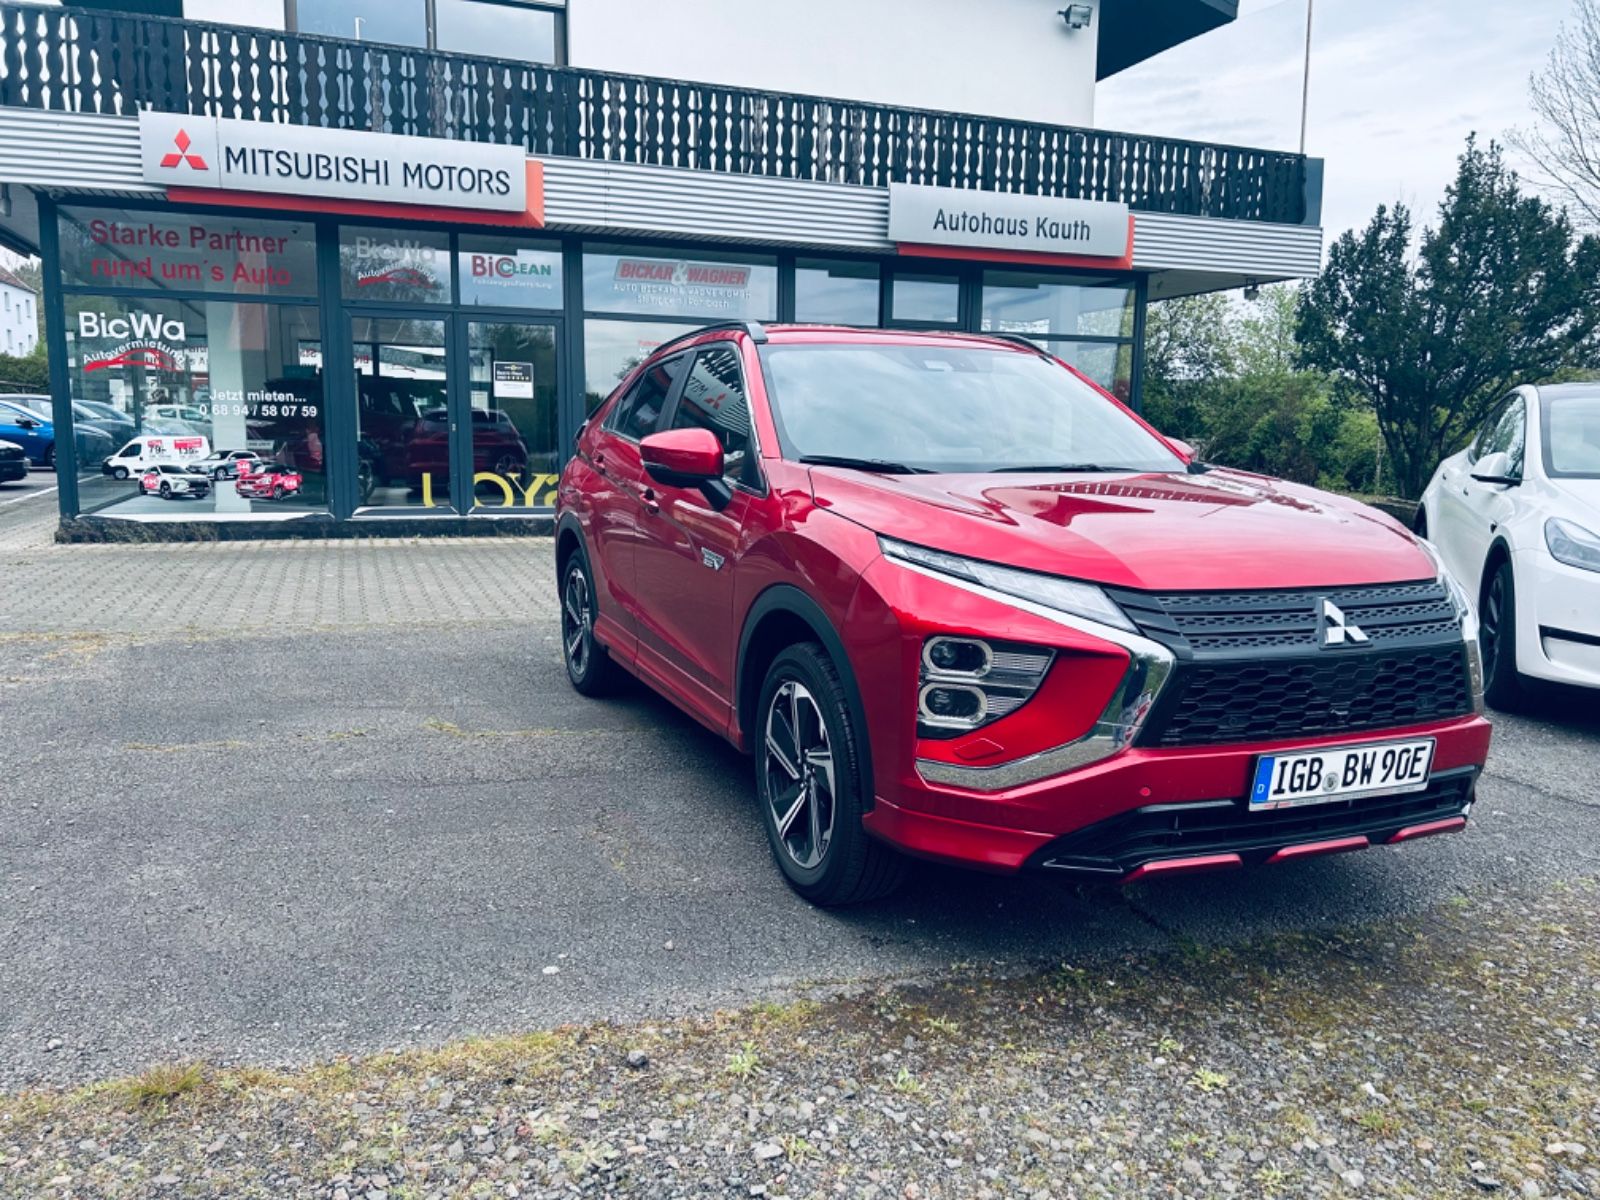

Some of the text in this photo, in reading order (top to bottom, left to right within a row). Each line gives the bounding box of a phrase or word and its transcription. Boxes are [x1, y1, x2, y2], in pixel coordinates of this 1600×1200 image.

[225, 146, 511, 195] MITSUBISHI MOTORS
[90, 219, 288, 254] Starke Partner
[933, 208, 1090, 241] Autohaus Kauth
[356, 236, 436, 264] BicWa
[91, 257, 152, 278] rund
[232, 262, 291, 286] Auto
[620, 261, 747, 286] BICKAR & WAGNER
[614, 283, 638, 293] AUTO
[78, 311, 186, 341] BicWa
[82, 338, 185, 368] Autovermietung
[209, 389, 244, 402] Jetzt
[200, 405, 207, 416] 0
[212, 405, 228, 417] 68
[232, 405, 249, 417] 94
[261, 406, 278, 417] 58
[282, 406, 298, 417] 07
[301, 406, 317, 418] 59
[1256, 783, 1265, 794] D
[1273, 757, 1323, 796] IGB
[1341, 751, 1377, 787] BW
[1381, 745, 1427, 784] 90E
